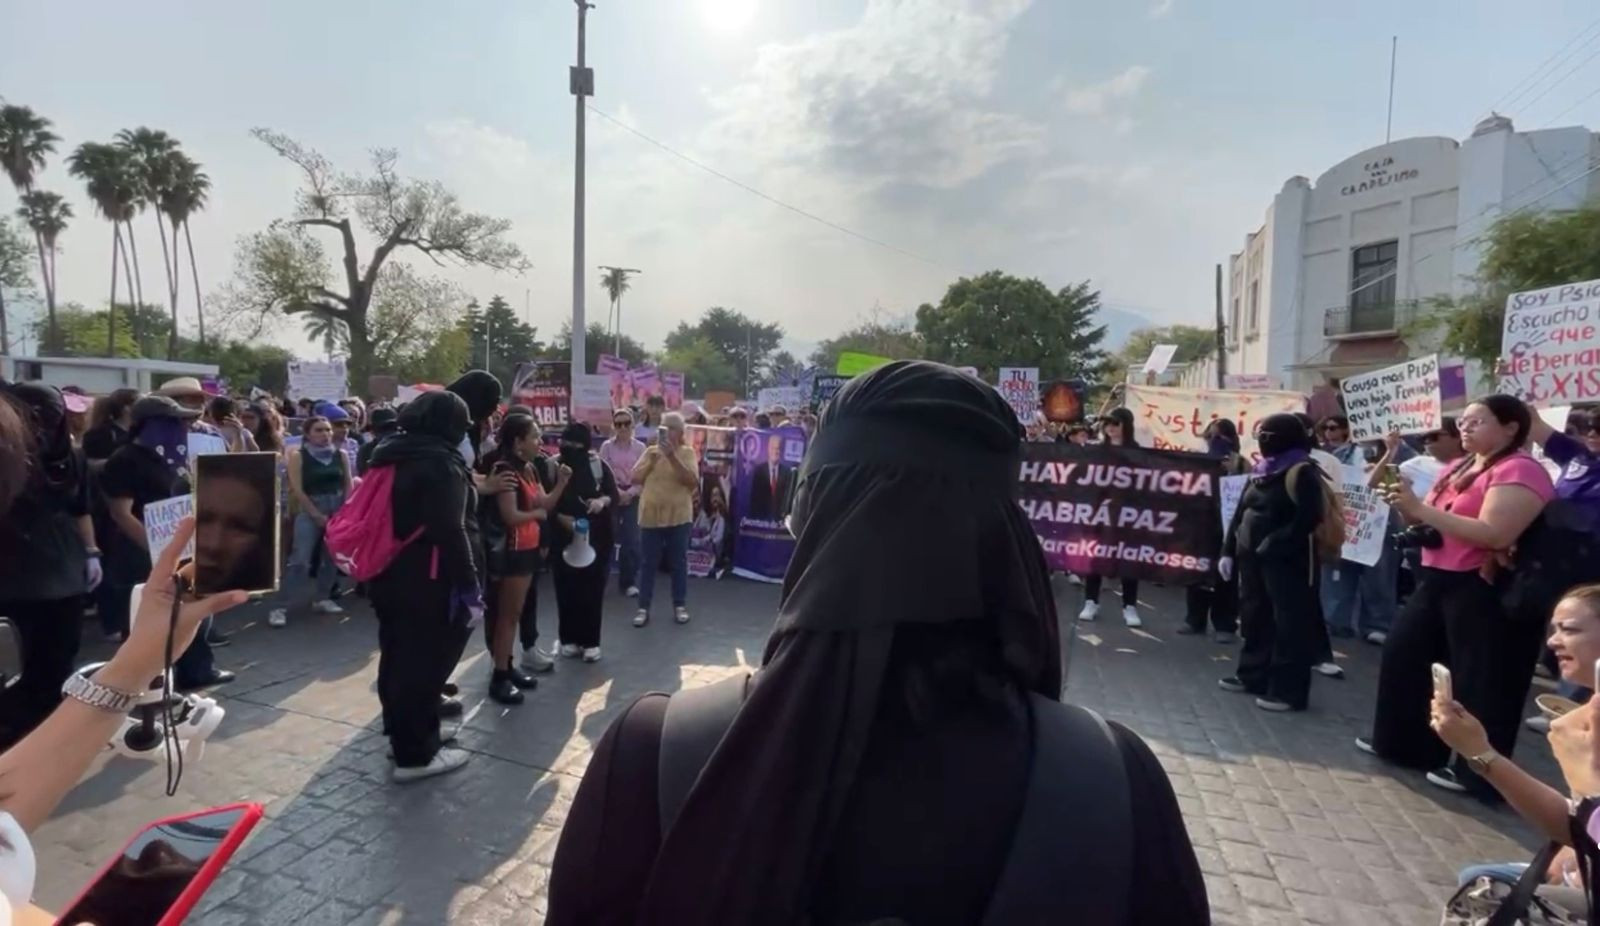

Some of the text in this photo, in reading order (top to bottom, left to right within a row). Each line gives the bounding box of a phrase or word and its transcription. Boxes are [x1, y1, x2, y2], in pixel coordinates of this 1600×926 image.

[1512, 292, 1549, 310] Soy
[1507, 305, 1588, 333] Escucho
[1550, 326, 1595, 345] que
[1019, 461, 1077, 484] HAY
[1076, 464, 1212, 496] JUSTICIA
[1018, 499, 1178, 533] HABRÁ PAZ
